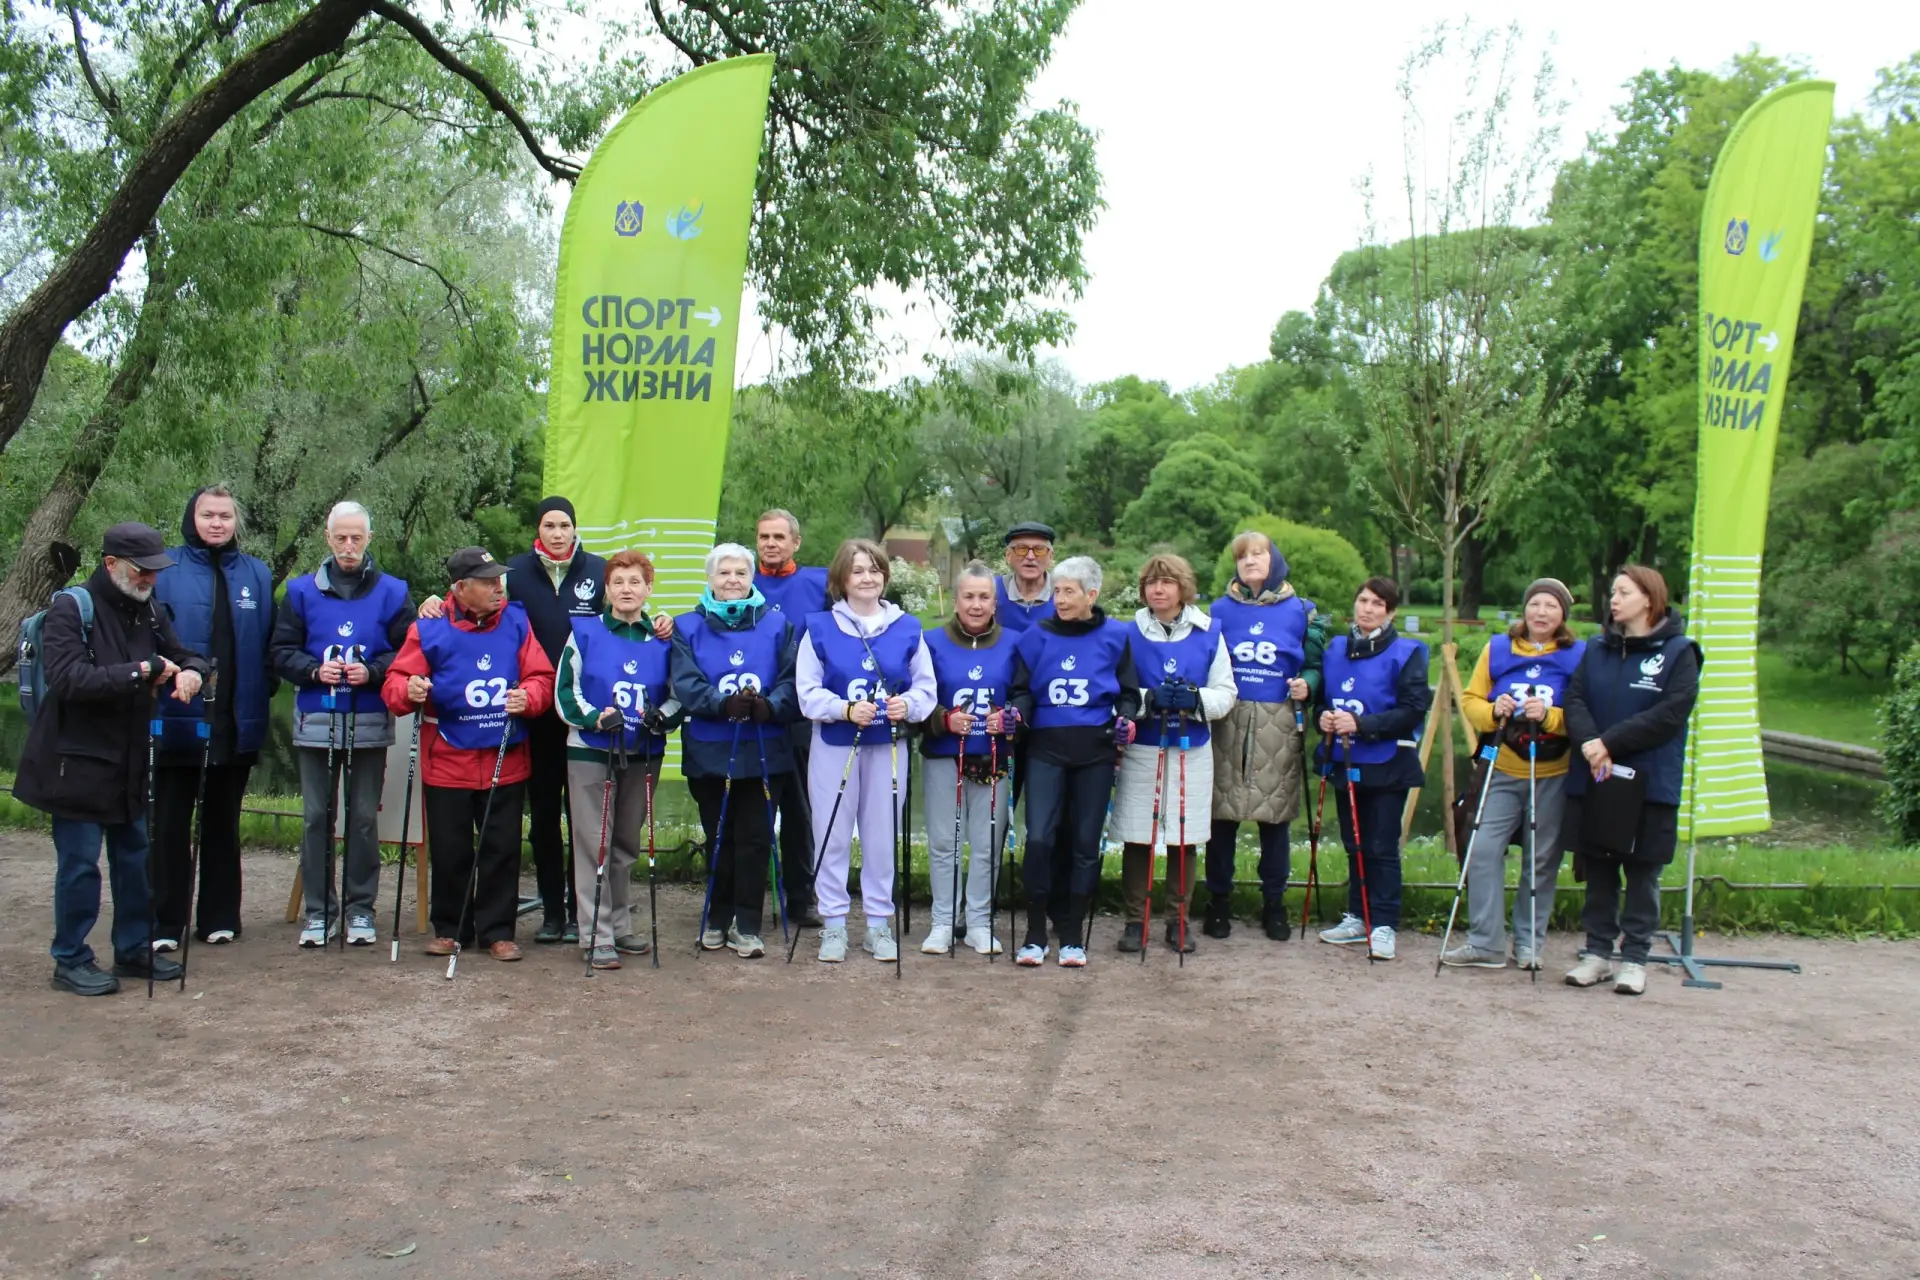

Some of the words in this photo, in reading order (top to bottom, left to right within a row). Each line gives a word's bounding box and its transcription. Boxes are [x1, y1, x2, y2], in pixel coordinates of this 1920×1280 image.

[582, 295, 696, 330] СПОРТ
[1706, 312, 1762, 354] ОРТ
[582, 333, 716, 368] НОРМА
[583, 369, 712, 402] ЖИЗНИ
[1707, 354, 1772, 394] РМА
[1233, 641, 1278, 666] 68
[464, 677, 508, 708] 62
[847, 678, 888, 704] 64
[1048, 678, 1090, 706] 63
[1241, 675, 1264, 684] РАЙОН
[953, 687, 995, 715] 65
[1510, 683, 1554, 708] 38
[479, 720, 505, 729] РАЙОН
